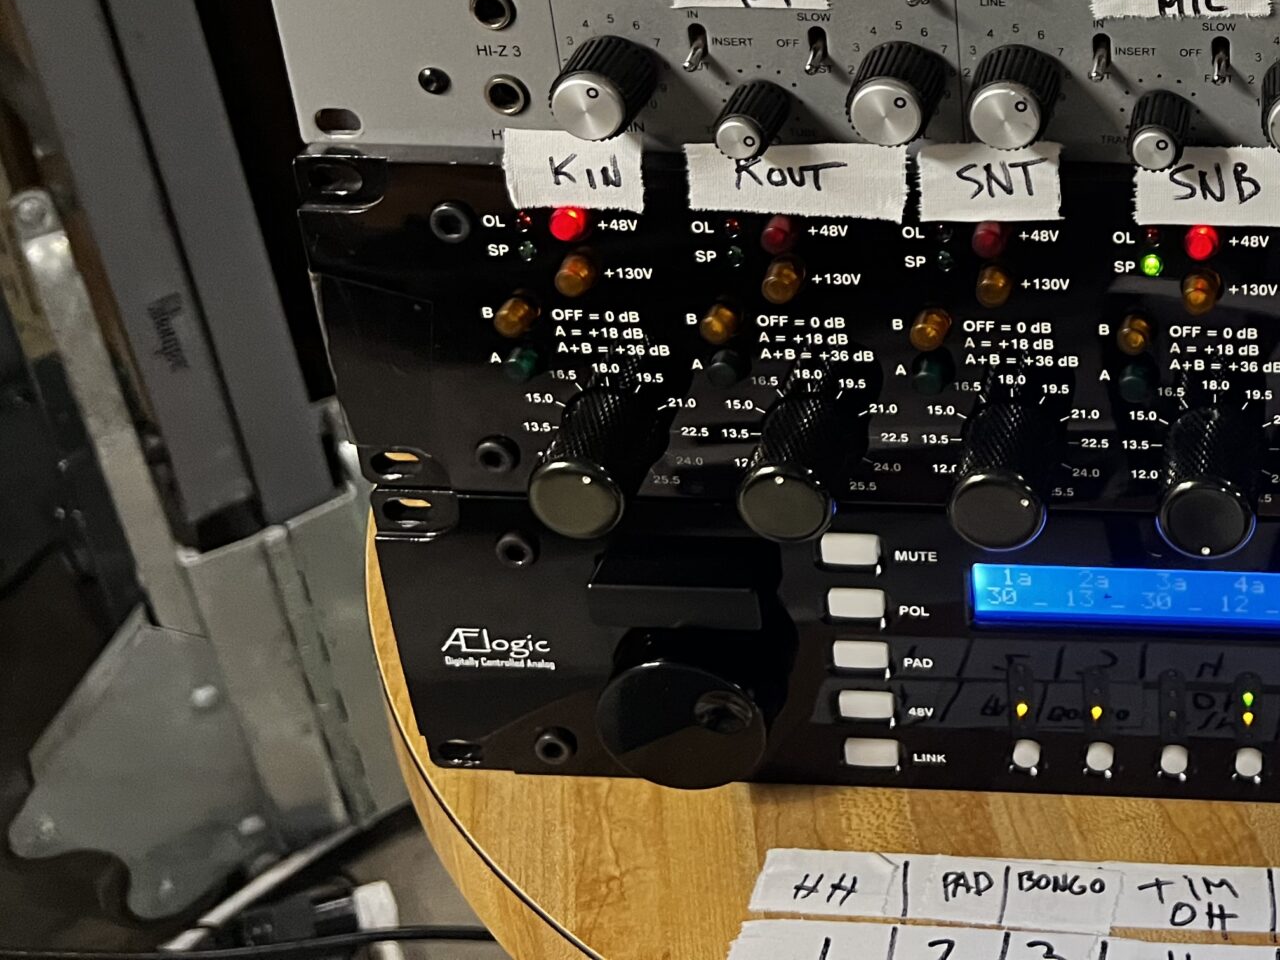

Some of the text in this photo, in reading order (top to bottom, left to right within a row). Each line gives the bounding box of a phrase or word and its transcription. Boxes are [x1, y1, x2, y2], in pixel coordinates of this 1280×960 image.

[797, 12, 831, 22] SLOW
[712, 38, 753, 47] INSERT
[477, 45, 521, 57] HI-Z 3
[894, 551, 937, 562] MUTE
[899, 605, 929, 617] POL
[445, 656, 555, 670] Digitally Controlled Analog
[903, 658, 933, 668] PAD
[908, 707, 934, 717] 48V
[913, 753, 946, 763] LINK
[942, 872, 994, 901] PAD
[1018, 871, 1105, 894] BONGO
